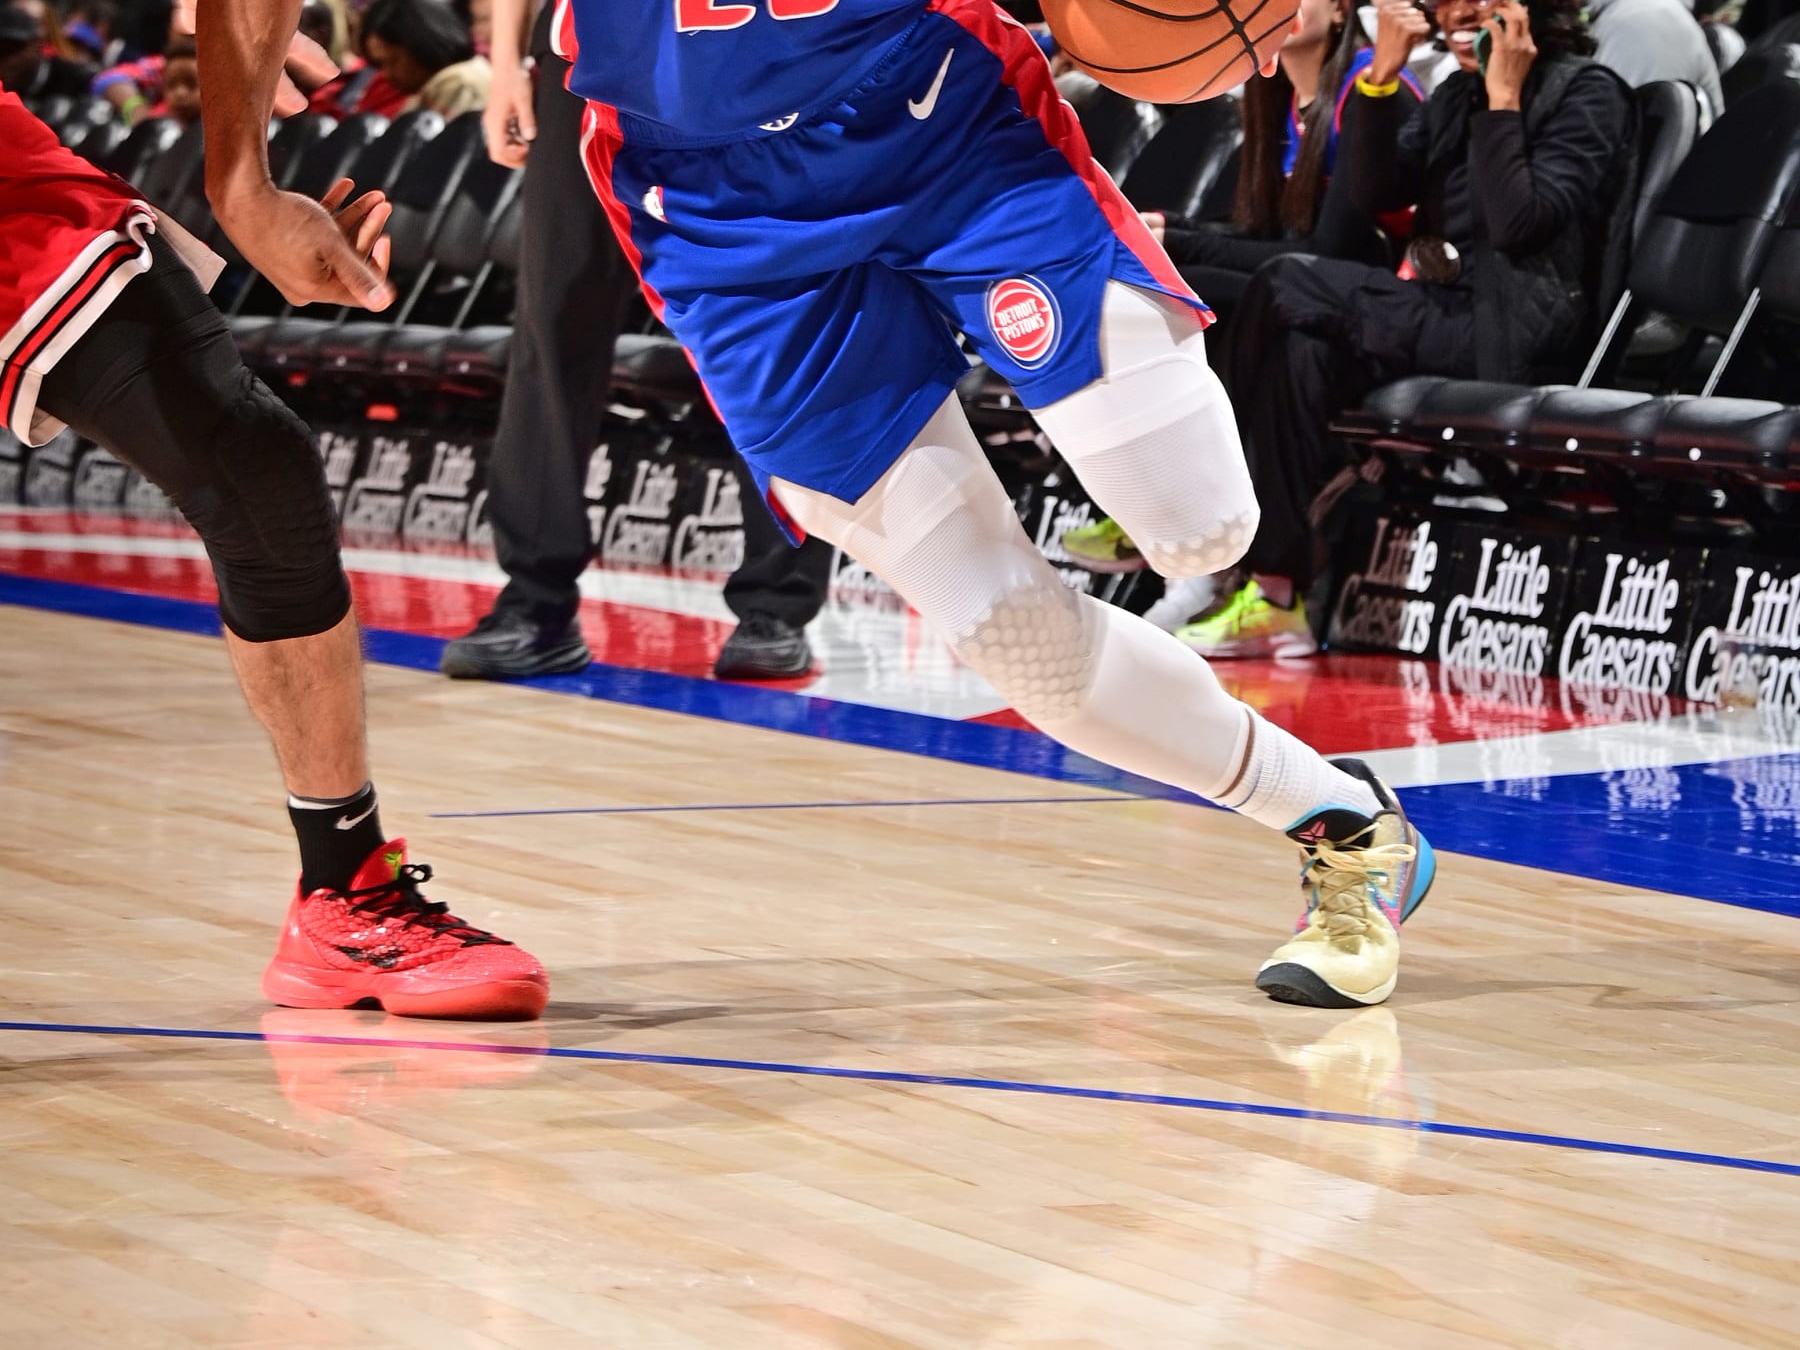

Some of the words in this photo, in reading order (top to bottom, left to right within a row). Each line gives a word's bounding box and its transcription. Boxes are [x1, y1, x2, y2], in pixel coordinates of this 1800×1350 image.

[995, 298, 1038, 327] DETROIT
[1001, 313, 1046, 342] PISTONS
[1364, 518, 1438, 593] Little
[1471, 539, 1550, 619] Little
[1592, 553, 1680, 634] Little
[1334, 573, 1435, 654] Caesars
[1439, 594, 1550, 677] Caesars
[1559, 611, 1677, 696] Caesars
